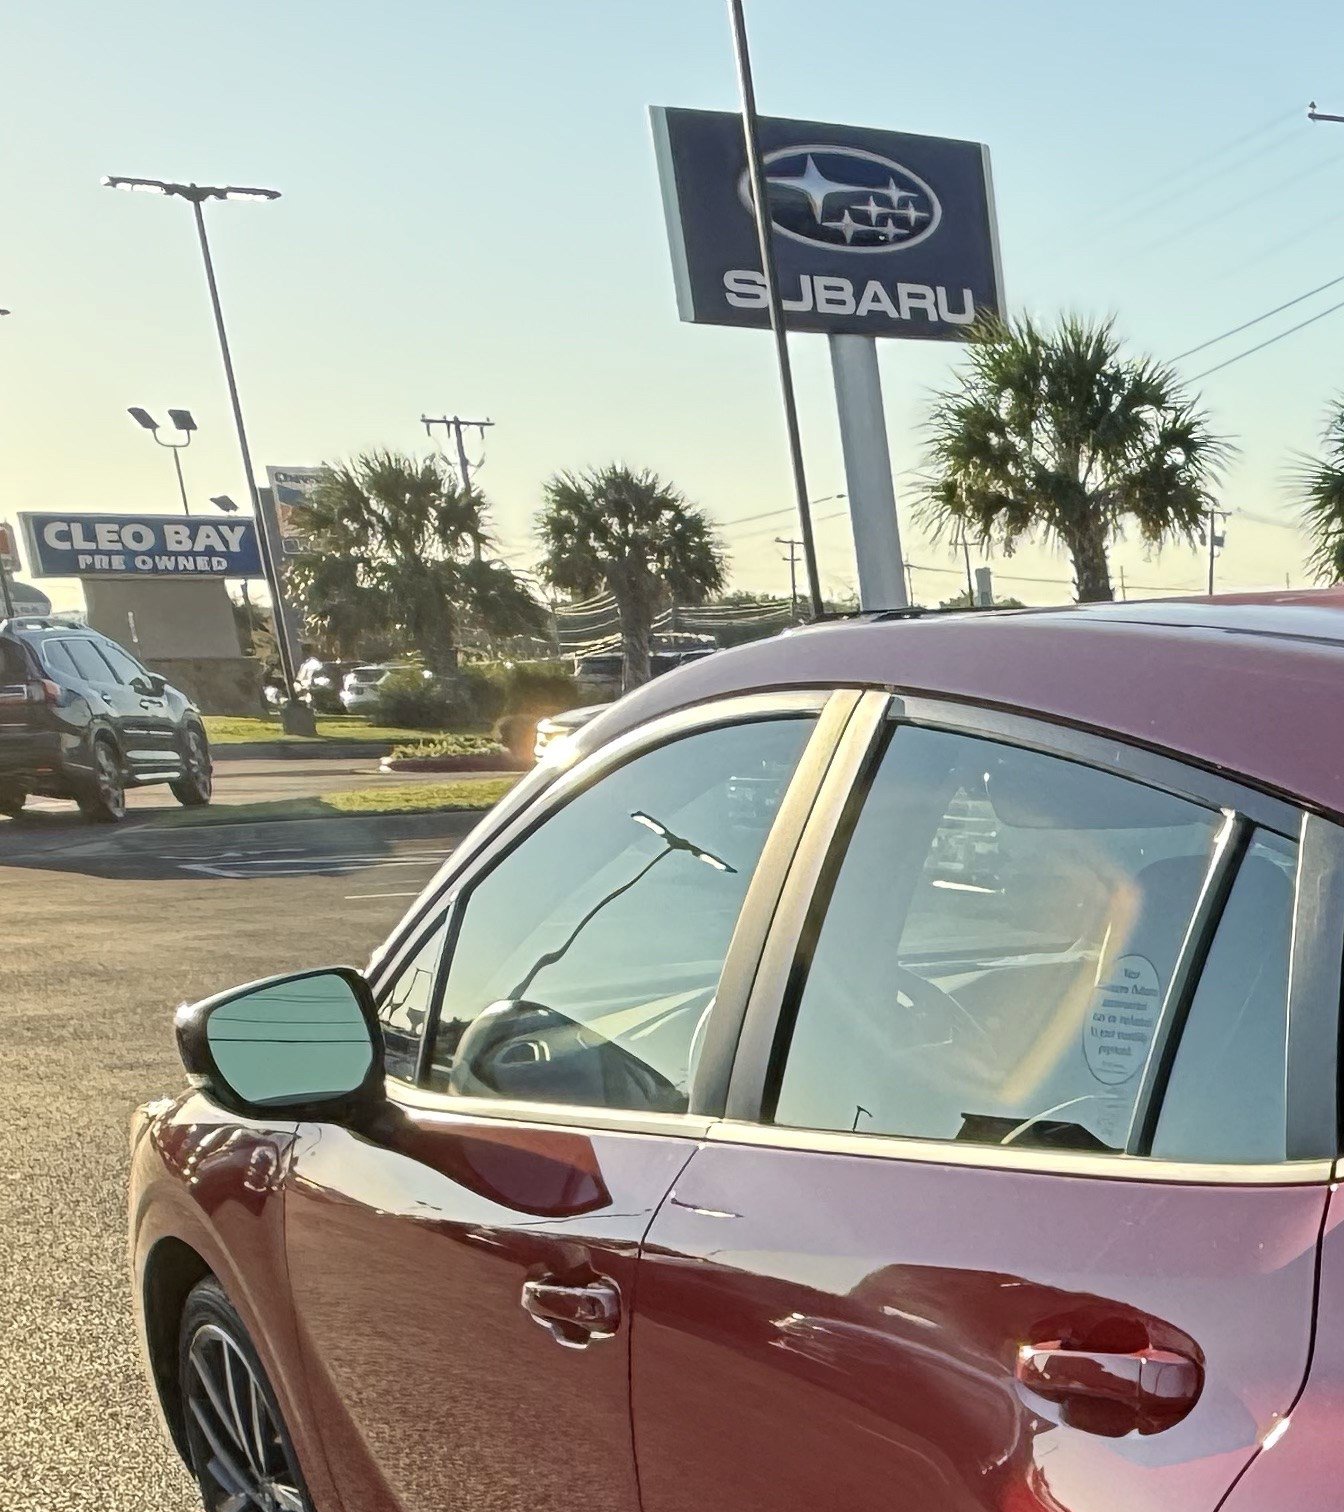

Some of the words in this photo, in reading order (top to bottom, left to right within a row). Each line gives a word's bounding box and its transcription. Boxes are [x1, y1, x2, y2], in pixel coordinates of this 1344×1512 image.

[44, 521, 155, 551] CLEO
[163, 523, 246, 552] BAY
[78, 554, 125, 570] PRE
[135, 555, 228, 571] OWNED
